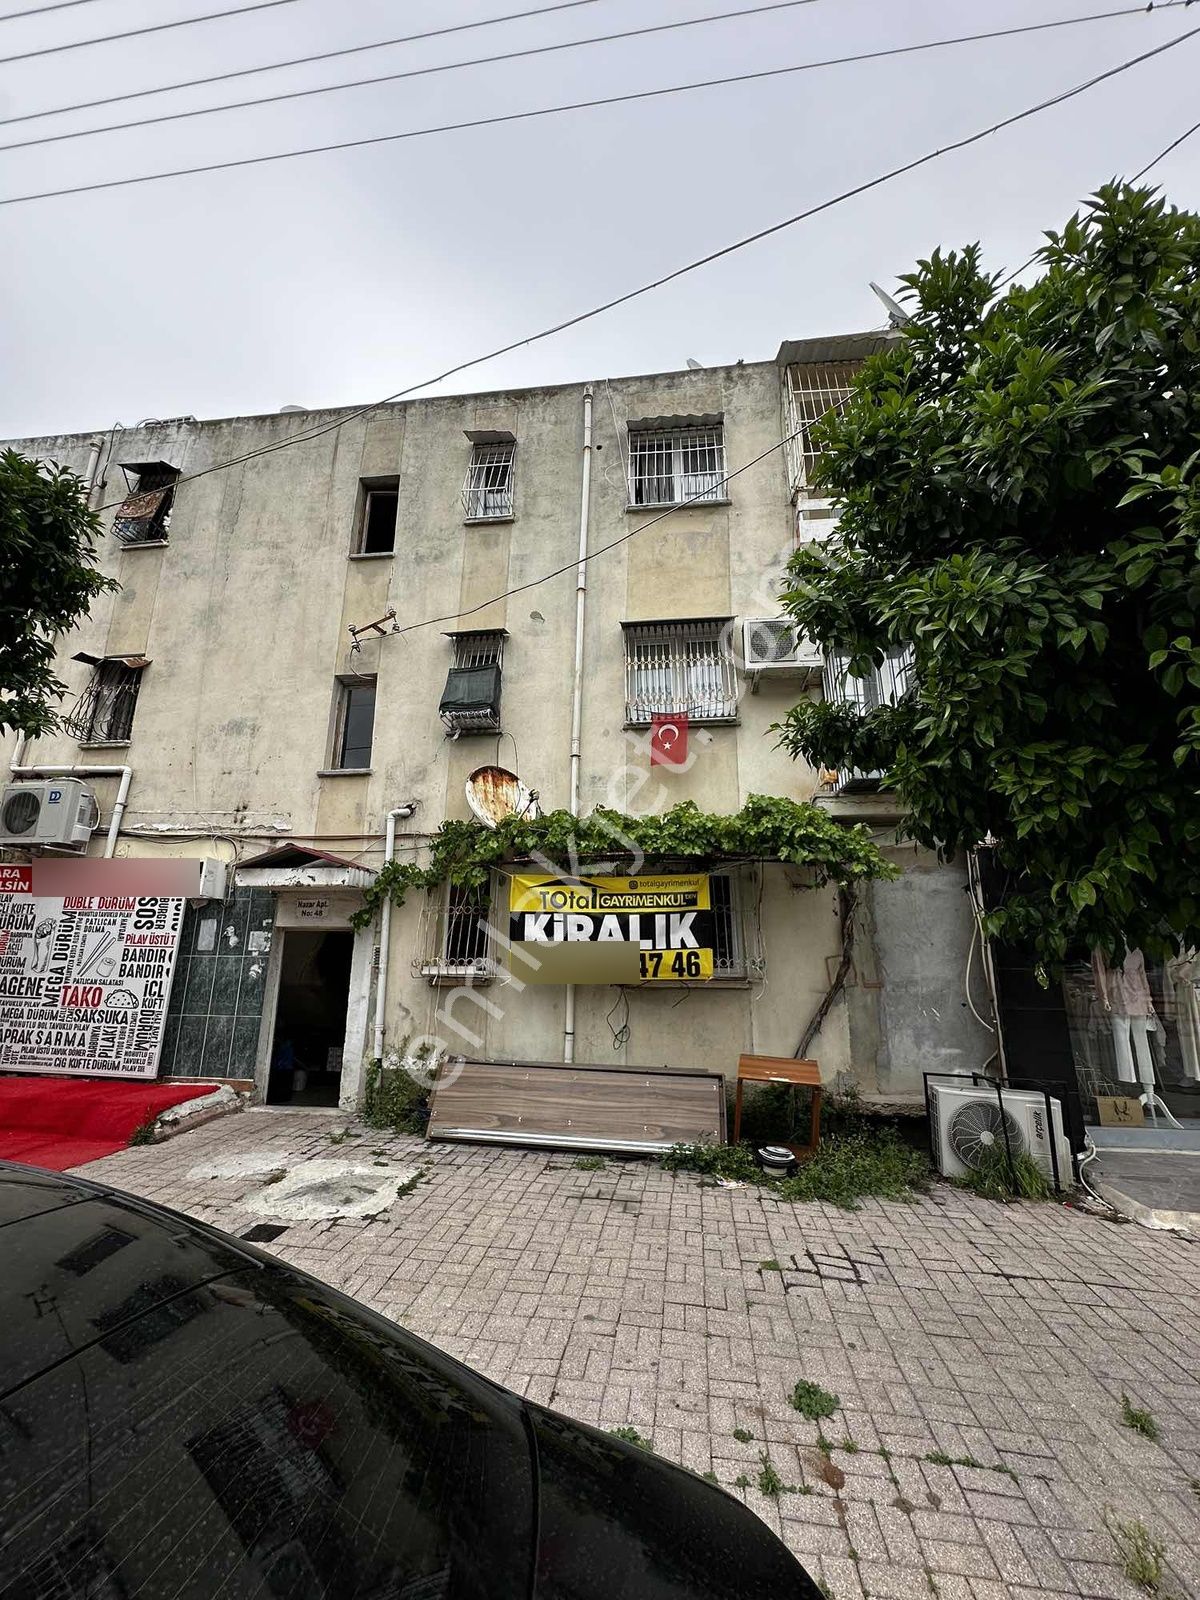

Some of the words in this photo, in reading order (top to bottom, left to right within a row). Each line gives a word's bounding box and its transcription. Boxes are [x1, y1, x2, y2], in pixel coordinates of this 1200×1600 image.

[0, 869, 20, 878] RA
[133, 897, 159, 930] SOS
[154, 898, 170, 930] BURGER
[0, 956, 27, 968] ÜRÜM
[121, 948, 167, 963] BANDIR
[671, 951, 700, 978] 46
[118, 964, 164, 978] BANDIR
[41, 966, 66, 1007] MEGA
[61, 985, 103, 1007] TAKO
[1, 1007, 24, 1019] MEGA
[35, 1030, 86, 1047] SARMA
[1033, 1110, 1044, 1140] arçelik
